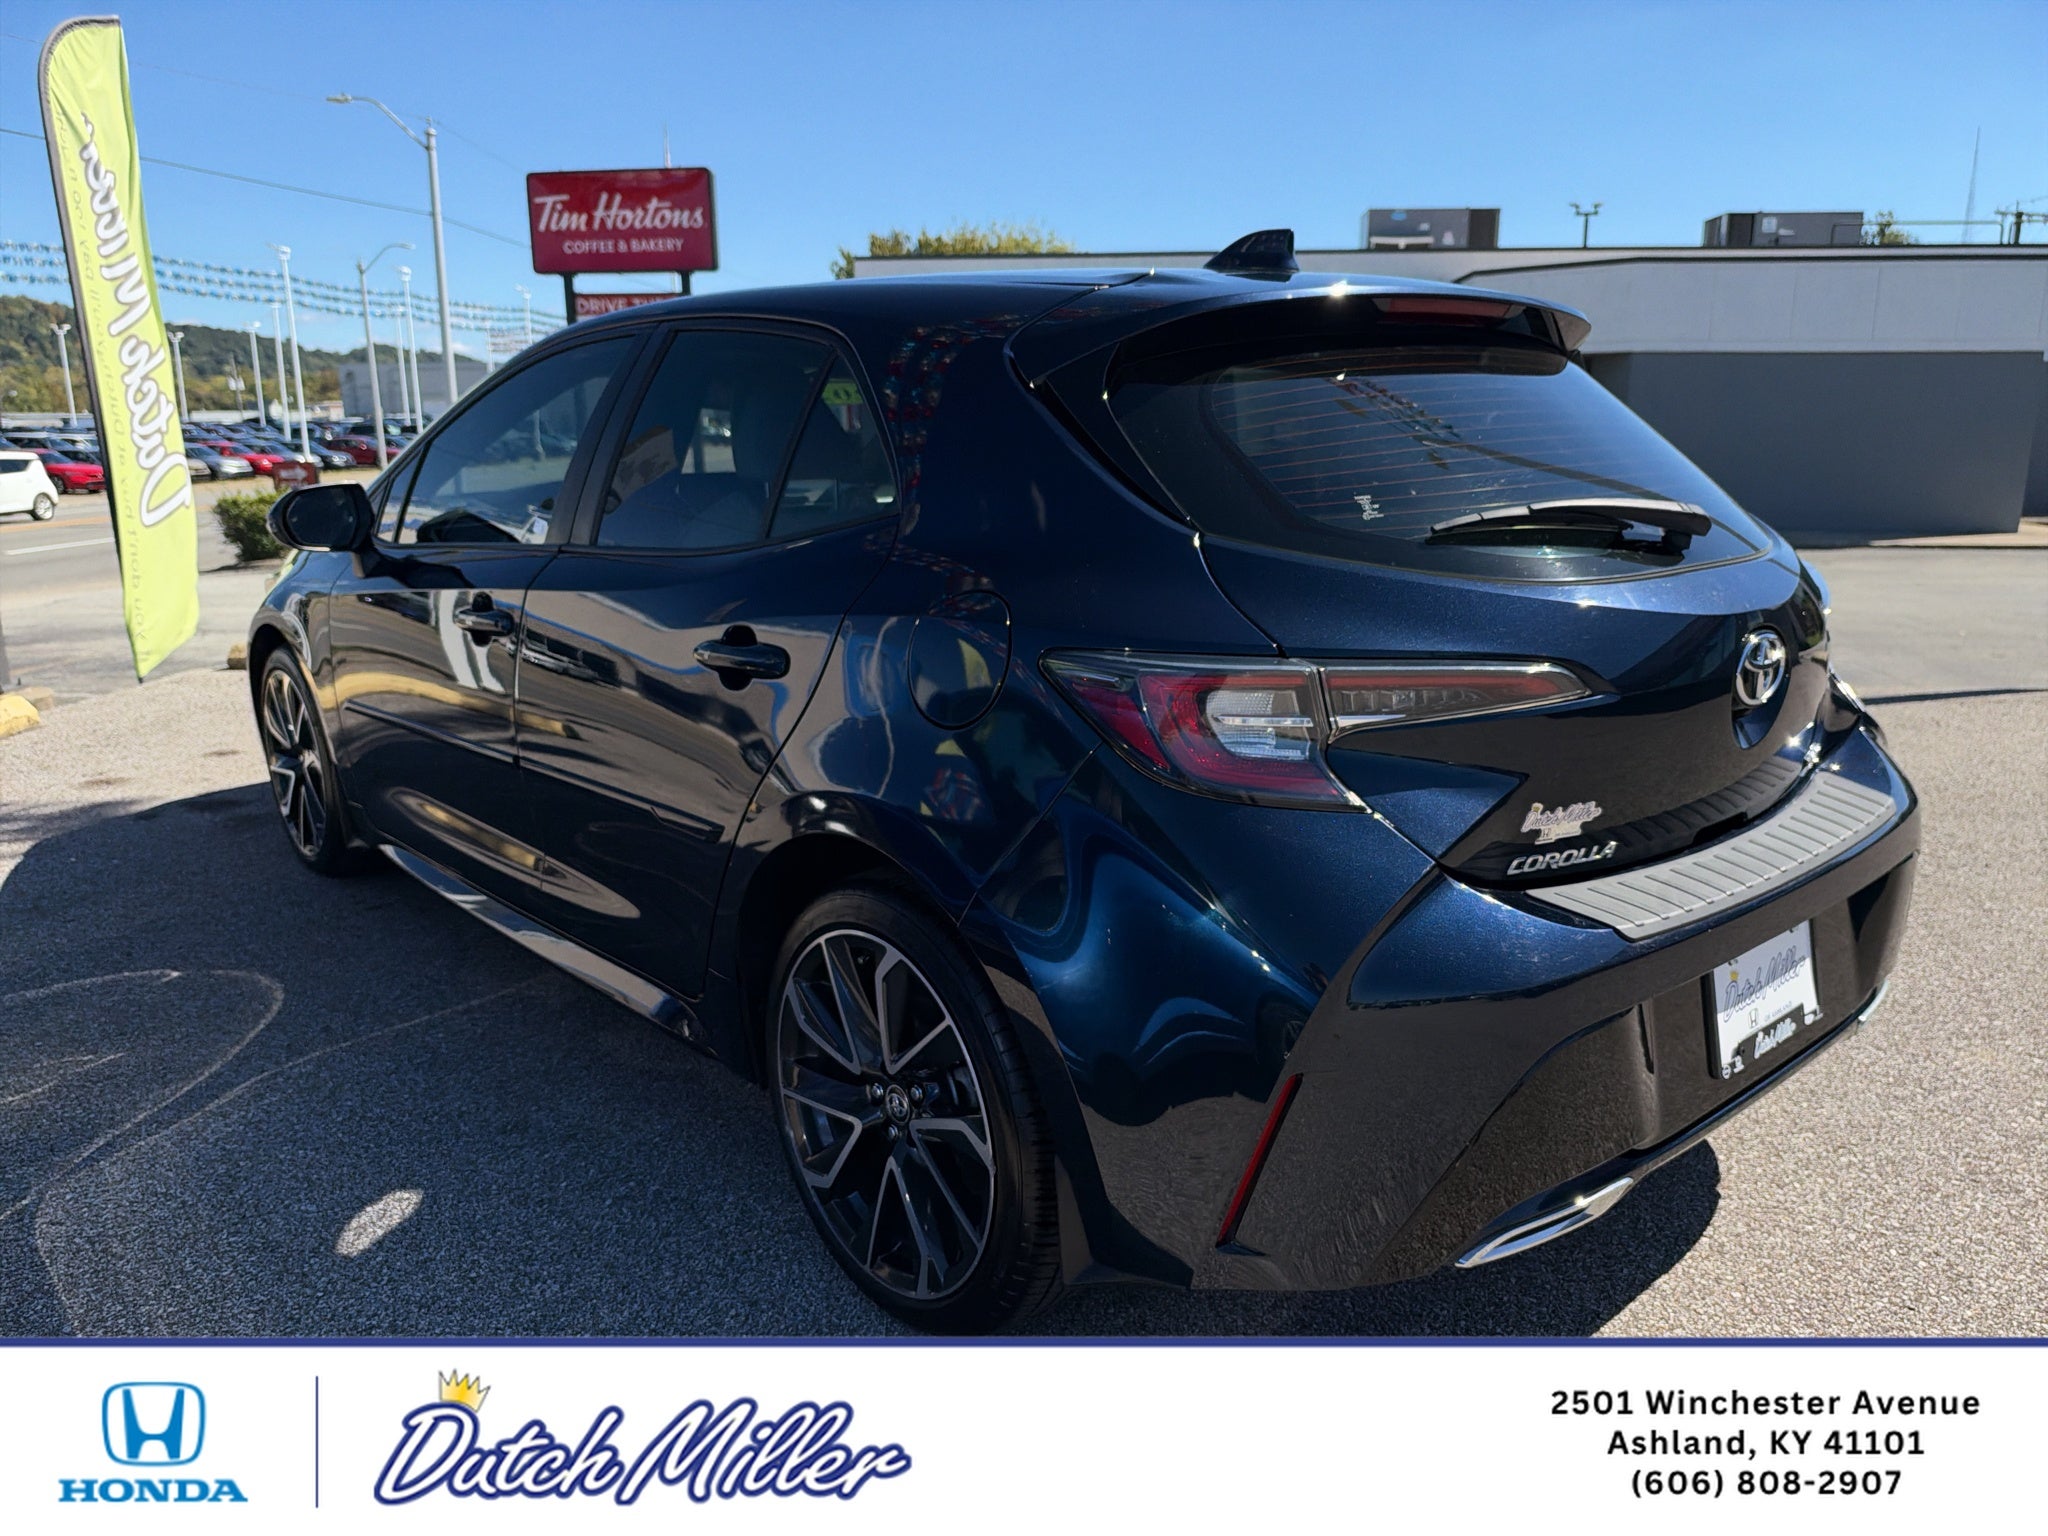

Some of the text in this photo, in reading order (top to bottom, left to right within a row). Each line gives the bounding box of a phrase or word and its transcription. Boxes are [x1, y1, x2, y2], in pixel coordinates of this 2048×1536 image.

[534, 190, 704, 233] Tim Hortons
[562, 237, 684, 254] COFFEE & BAKERY
[577, 296, 629, 314] DRIVE
[1506, 840, 1618, 876] COROLLA
[1722, 944, 1807, 1023] Dutch Miller
